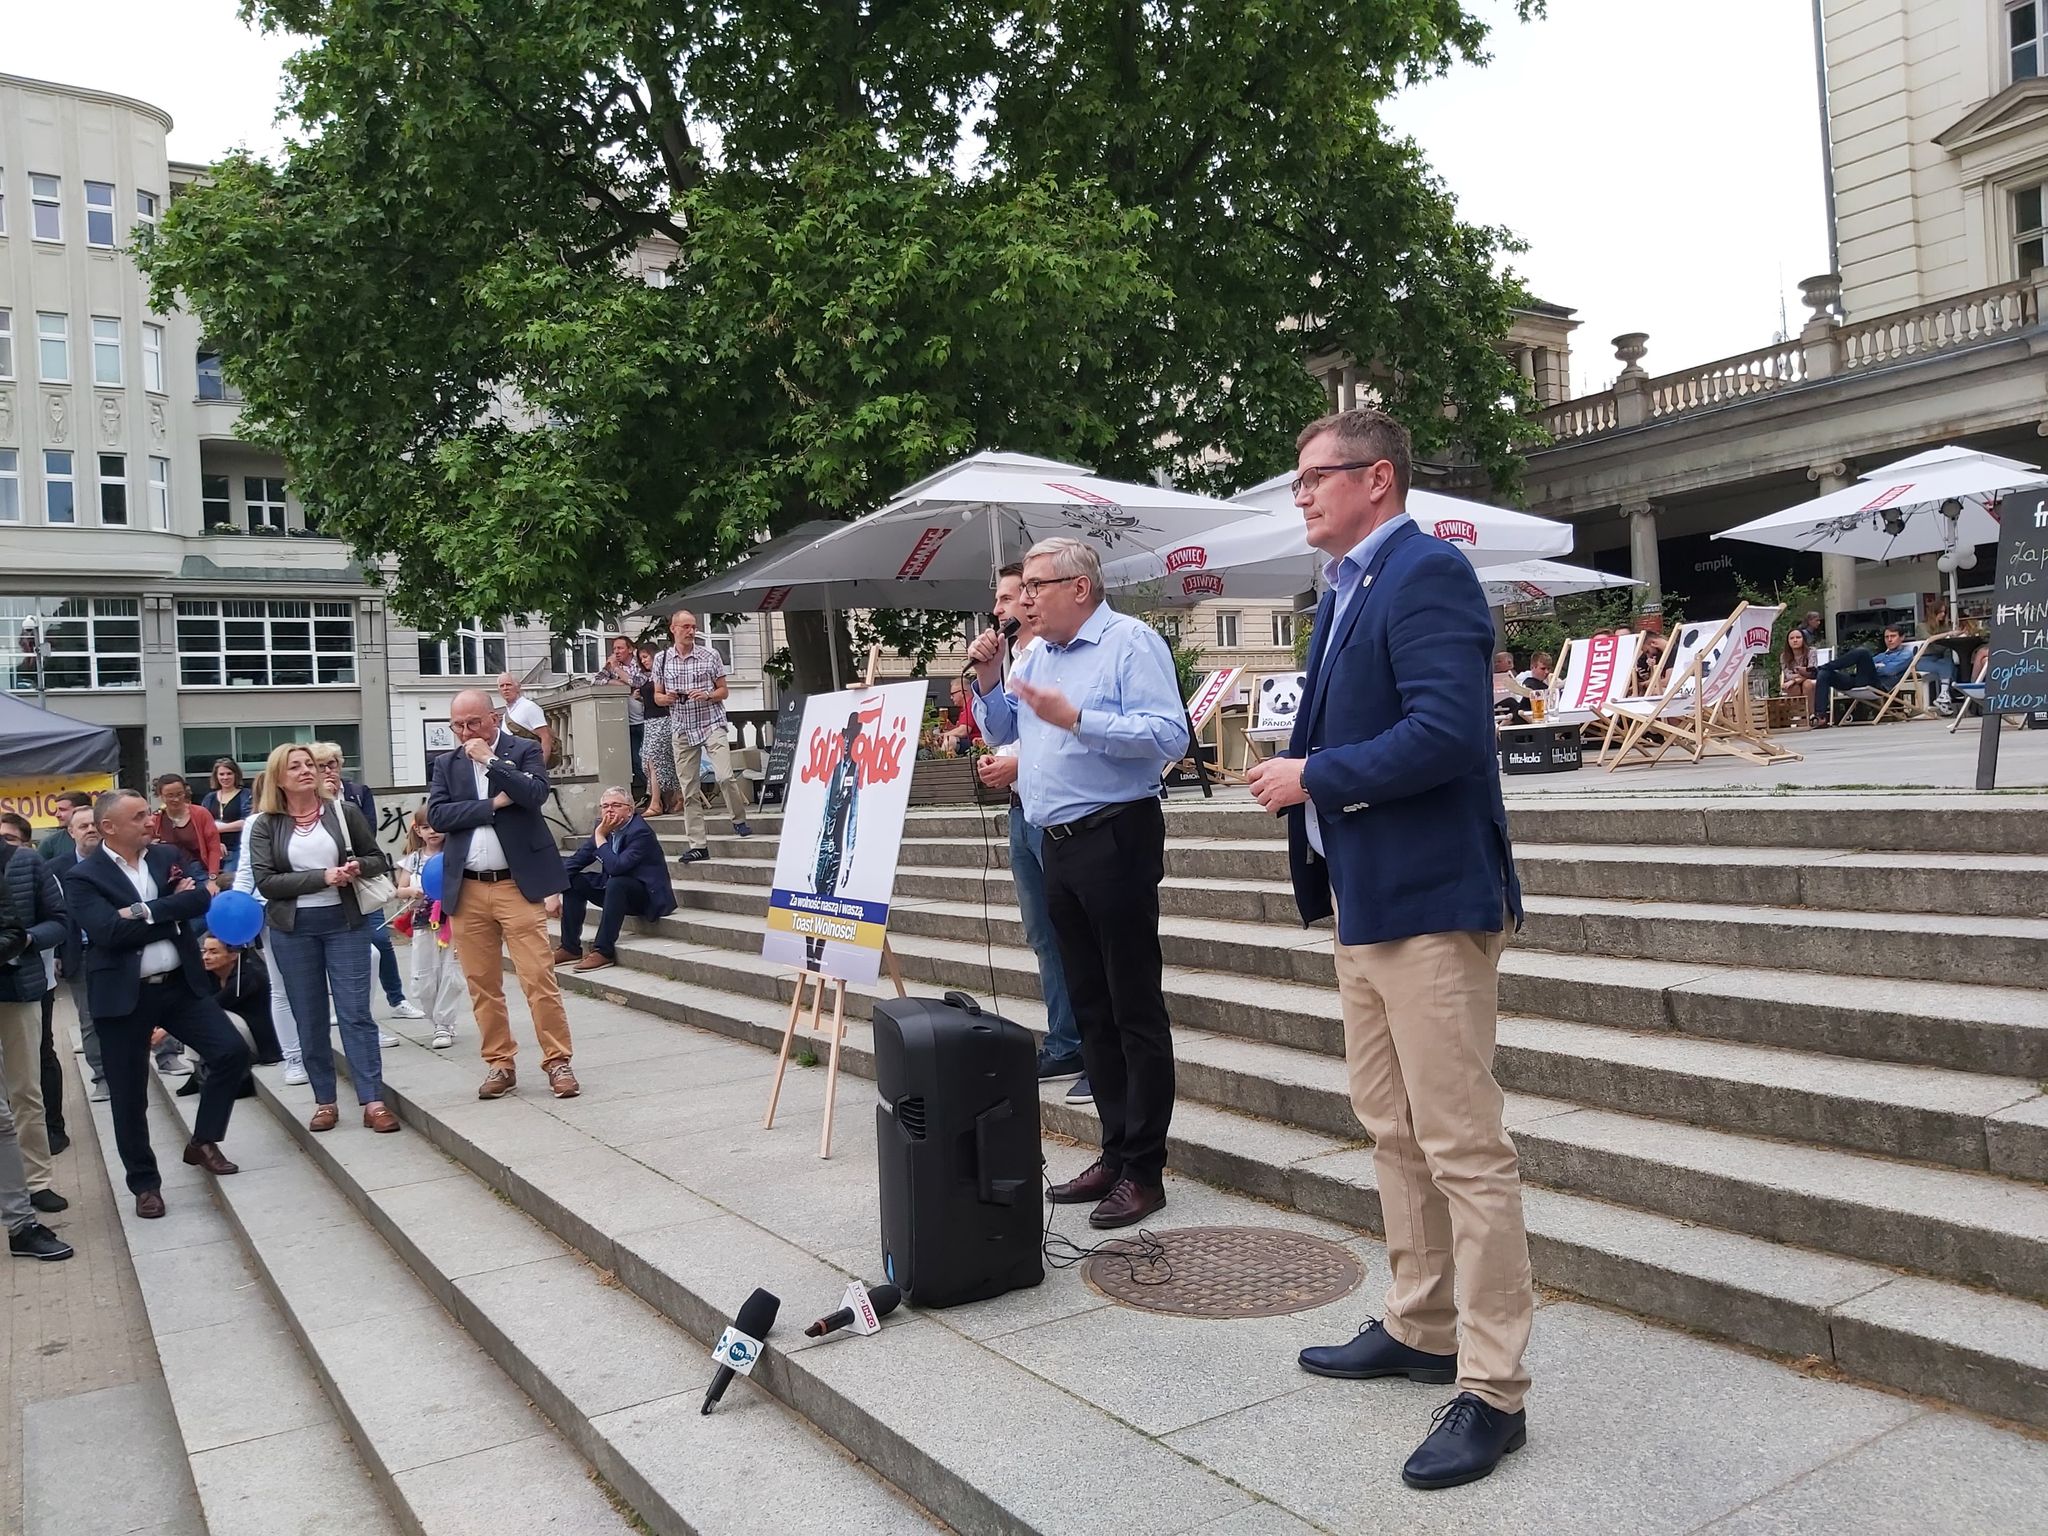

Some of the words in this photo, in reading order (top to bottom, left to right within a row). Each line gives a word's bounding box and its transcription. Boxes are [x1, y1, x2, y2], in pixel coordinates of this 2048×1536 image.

[1437, 521, 1473, 538] ŻYWIEC
[1169, 548, 1203, 568] ŻYWIEC
[1694, 554, 1733, 572] empik
[789, 893, 798, 906] Za
[797, 895, 821, 910] wolność
[820, 900, 838, 916] naszą
[792, 912, 814, 933] Toast
[814, 916, 857, 941] Wolności!
[862, 1304, 875, 1328] INFO
